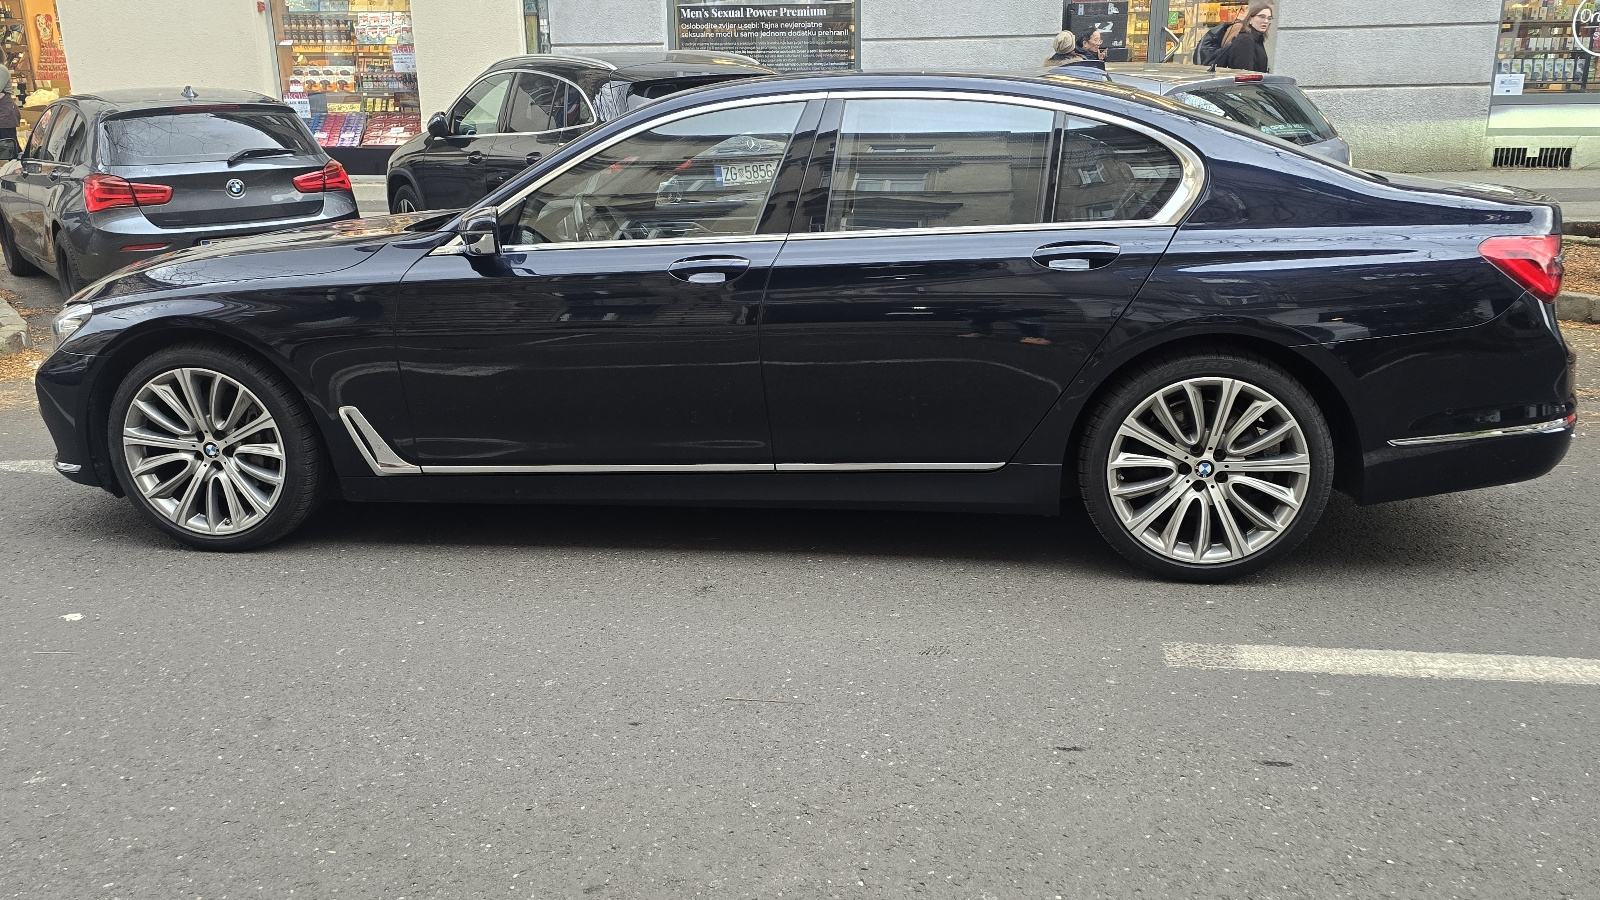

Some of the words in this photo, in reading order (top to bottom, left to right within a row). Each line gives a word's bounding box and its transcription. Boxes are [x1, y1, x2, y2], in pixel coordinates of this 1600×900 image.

[680, 8, 709, 18] Men's
[711, 7, 744, 18] Sexual
[746, 7, 778, 17] Power
[779, 6, 827, 17] Premium
[760, 21, 779, 29] Tajna
[780, 21, 823, 29] nevjerojatne
[759, 30, 787, 38] jednom
[787, 29, 817, 37] dodatku
[723, 166, 738, 181] ZG
